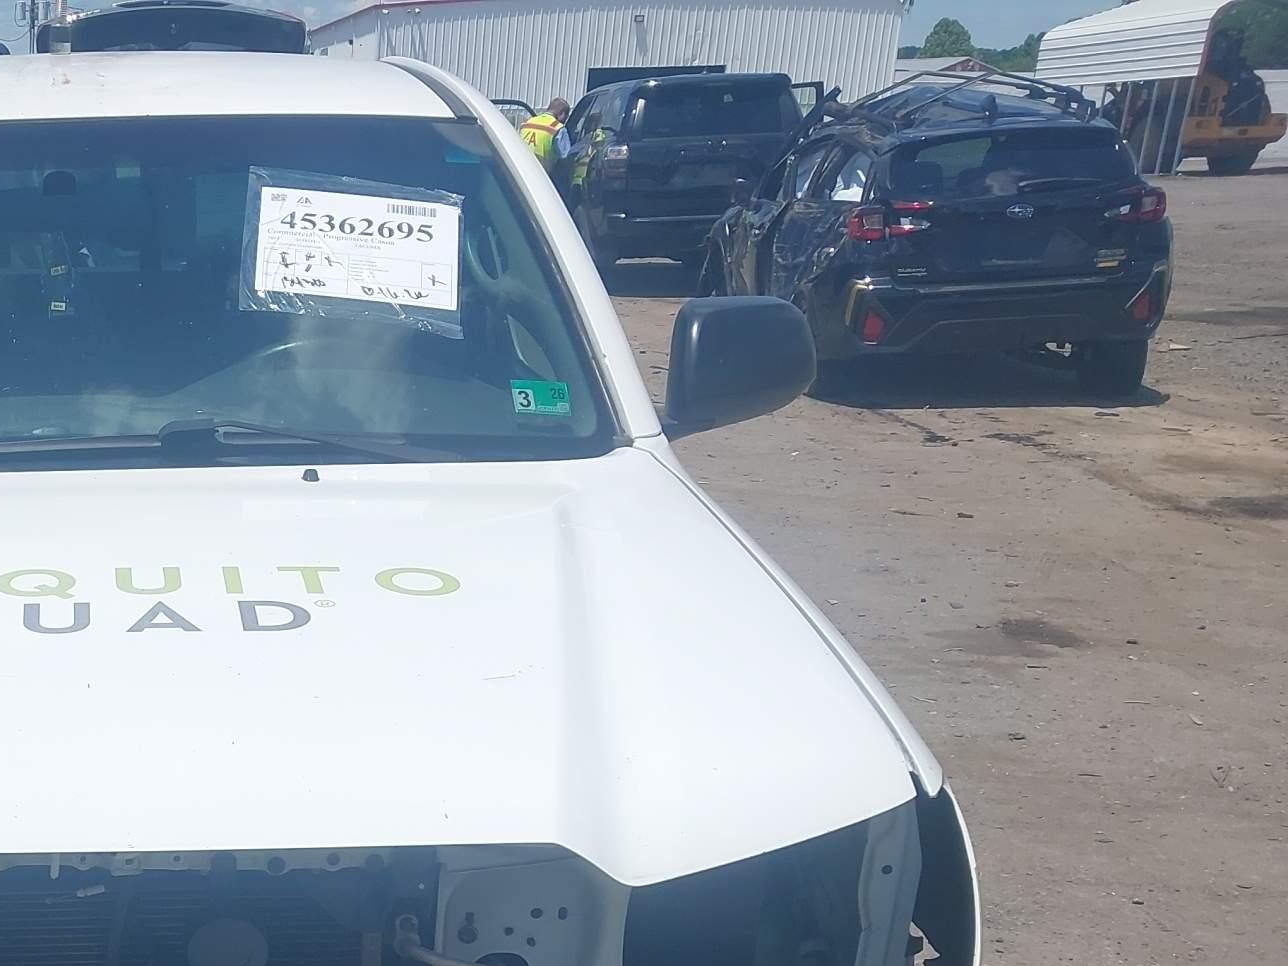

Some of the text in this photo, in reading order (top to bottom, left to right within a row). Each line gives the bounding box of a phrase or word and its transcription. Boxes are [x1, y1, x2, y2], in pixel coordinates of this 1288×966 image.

[280, 211, 434, 242] 45362695
[518, 387, 565, 408] 3 26
